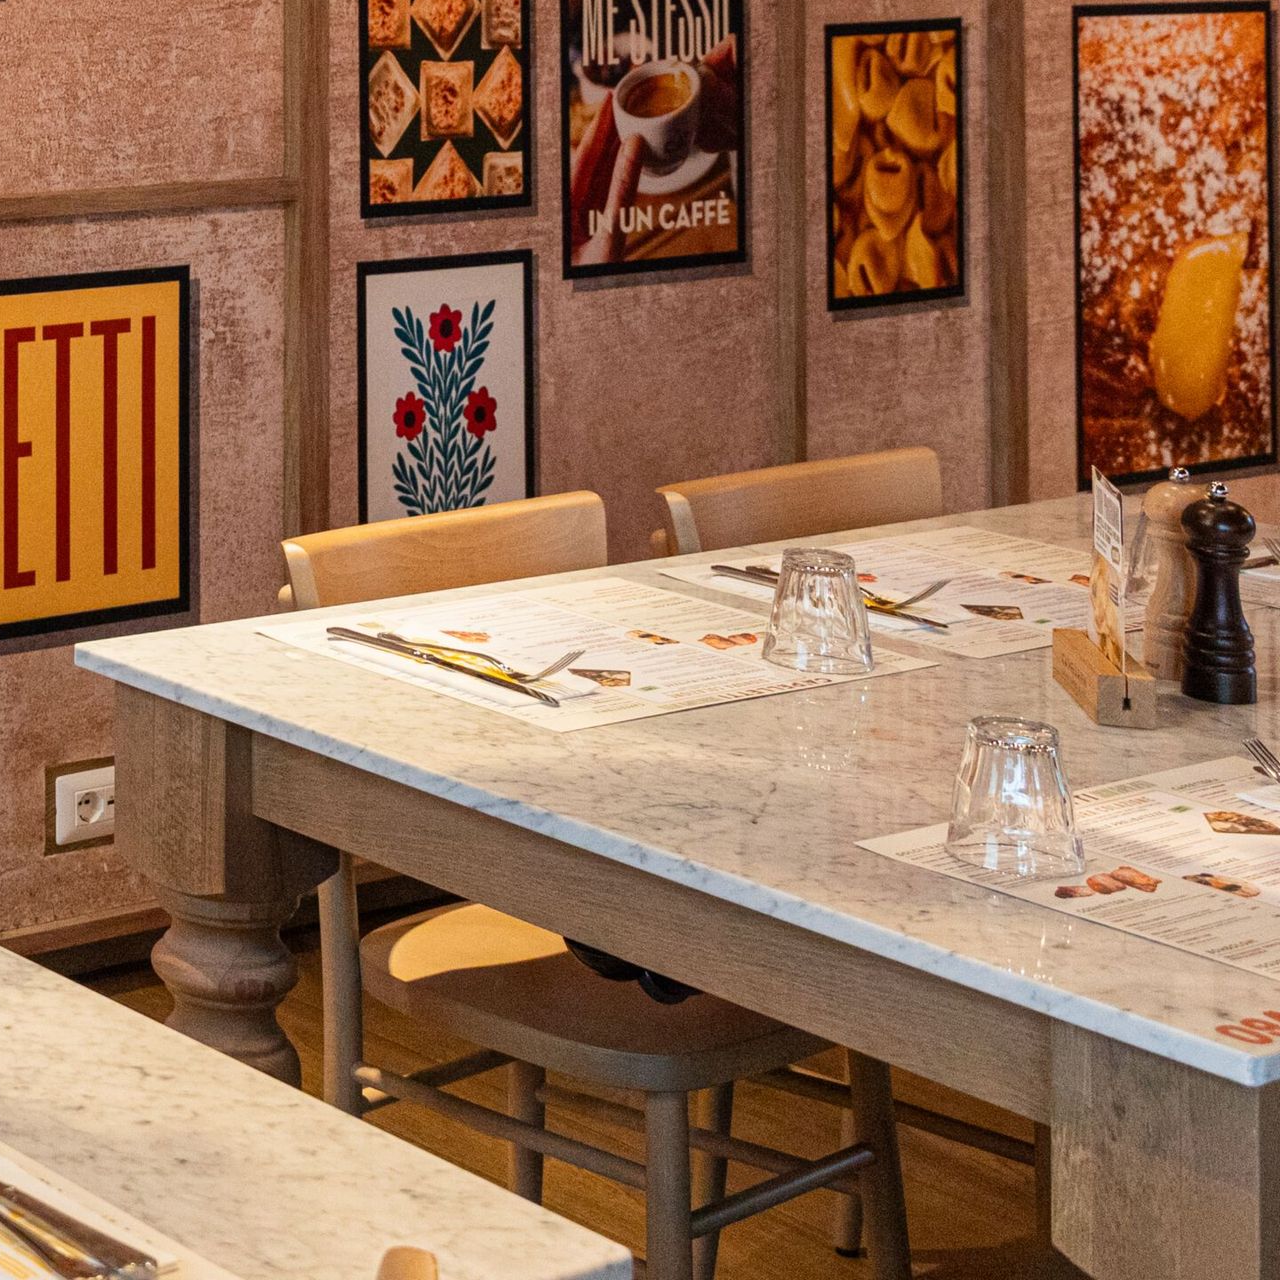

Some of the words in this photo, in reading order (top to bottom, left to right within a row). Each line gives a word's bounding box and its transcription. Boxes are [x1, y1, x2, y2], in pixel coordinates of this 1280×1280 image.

[589, 209, 613, 236] IN
[620, 204, 653, 233] UN
[658, 191, 731, 230] CAFFÈ
